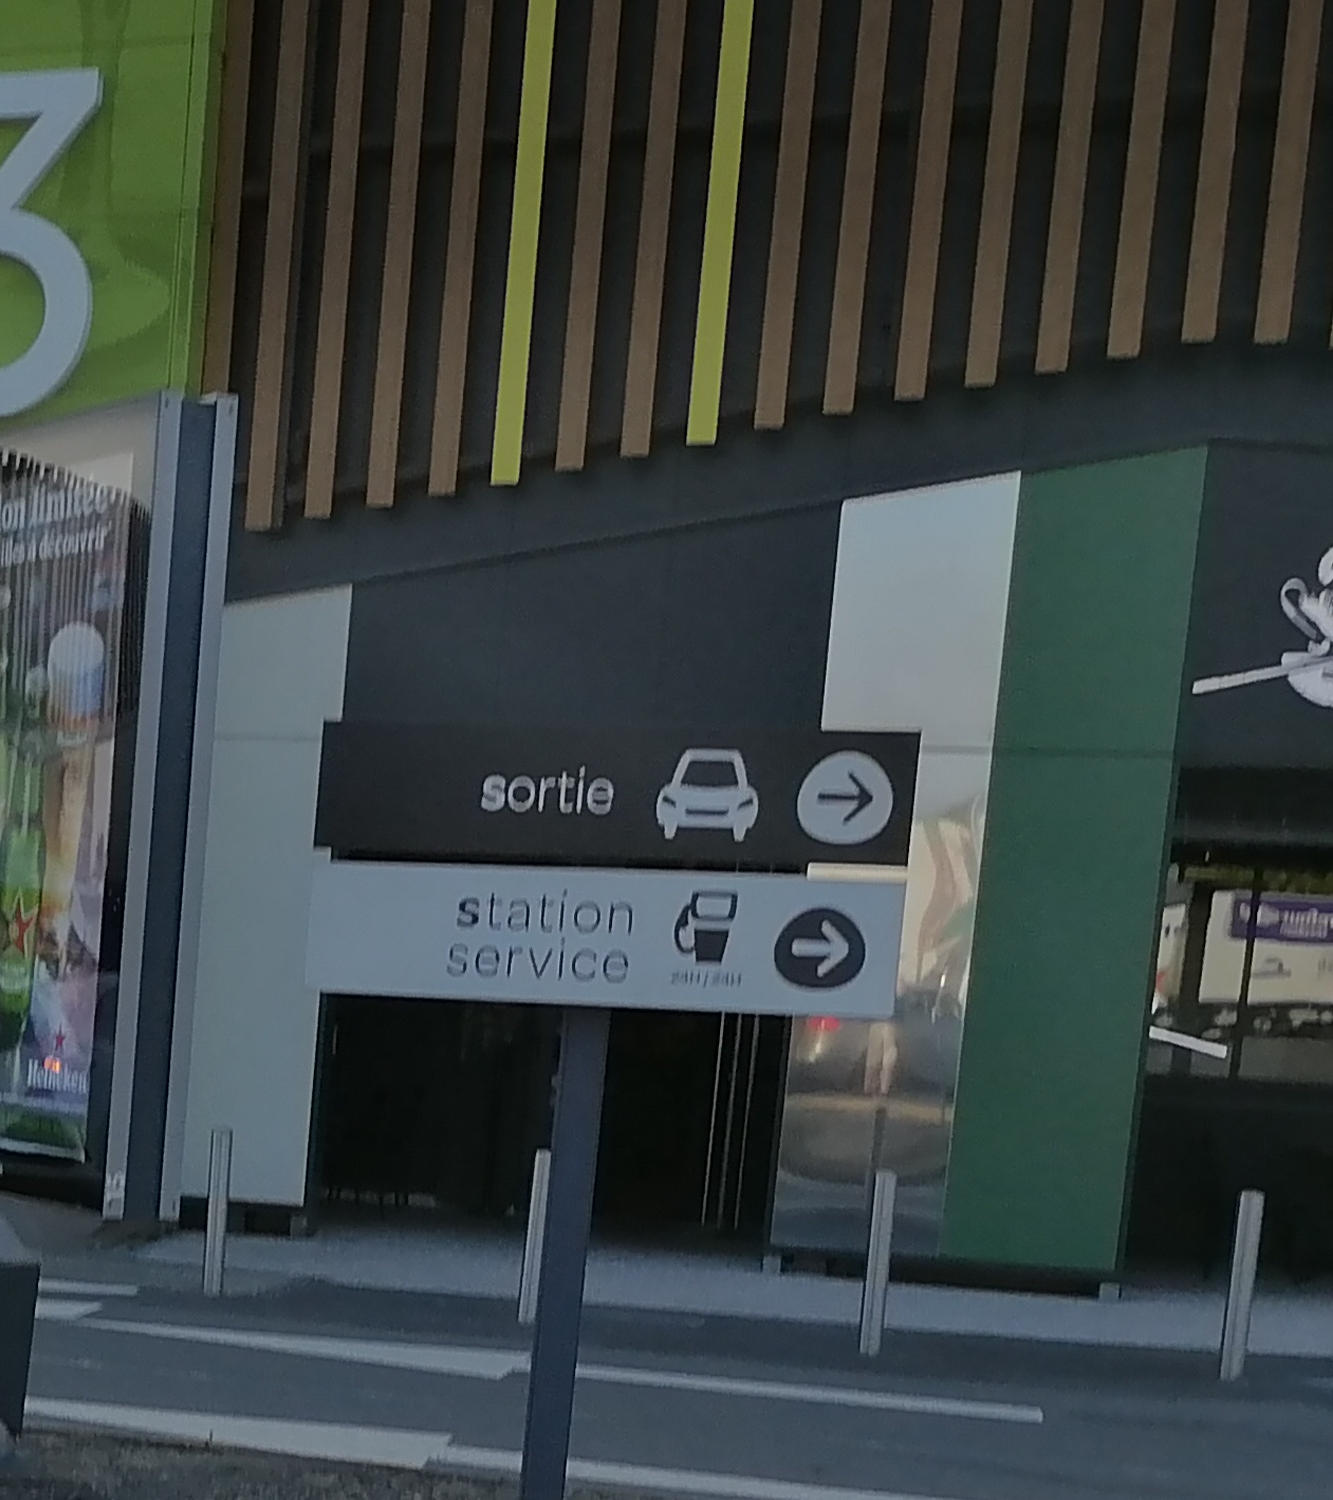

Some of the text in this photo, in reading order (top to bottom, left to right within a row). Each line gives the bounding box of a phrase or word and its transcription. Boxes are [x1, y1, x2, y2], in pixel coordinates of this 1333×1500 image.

[481, 765, 614, 816] sortie
[456, 889, 634, 936] station
[446, 936, 630, 984] service
